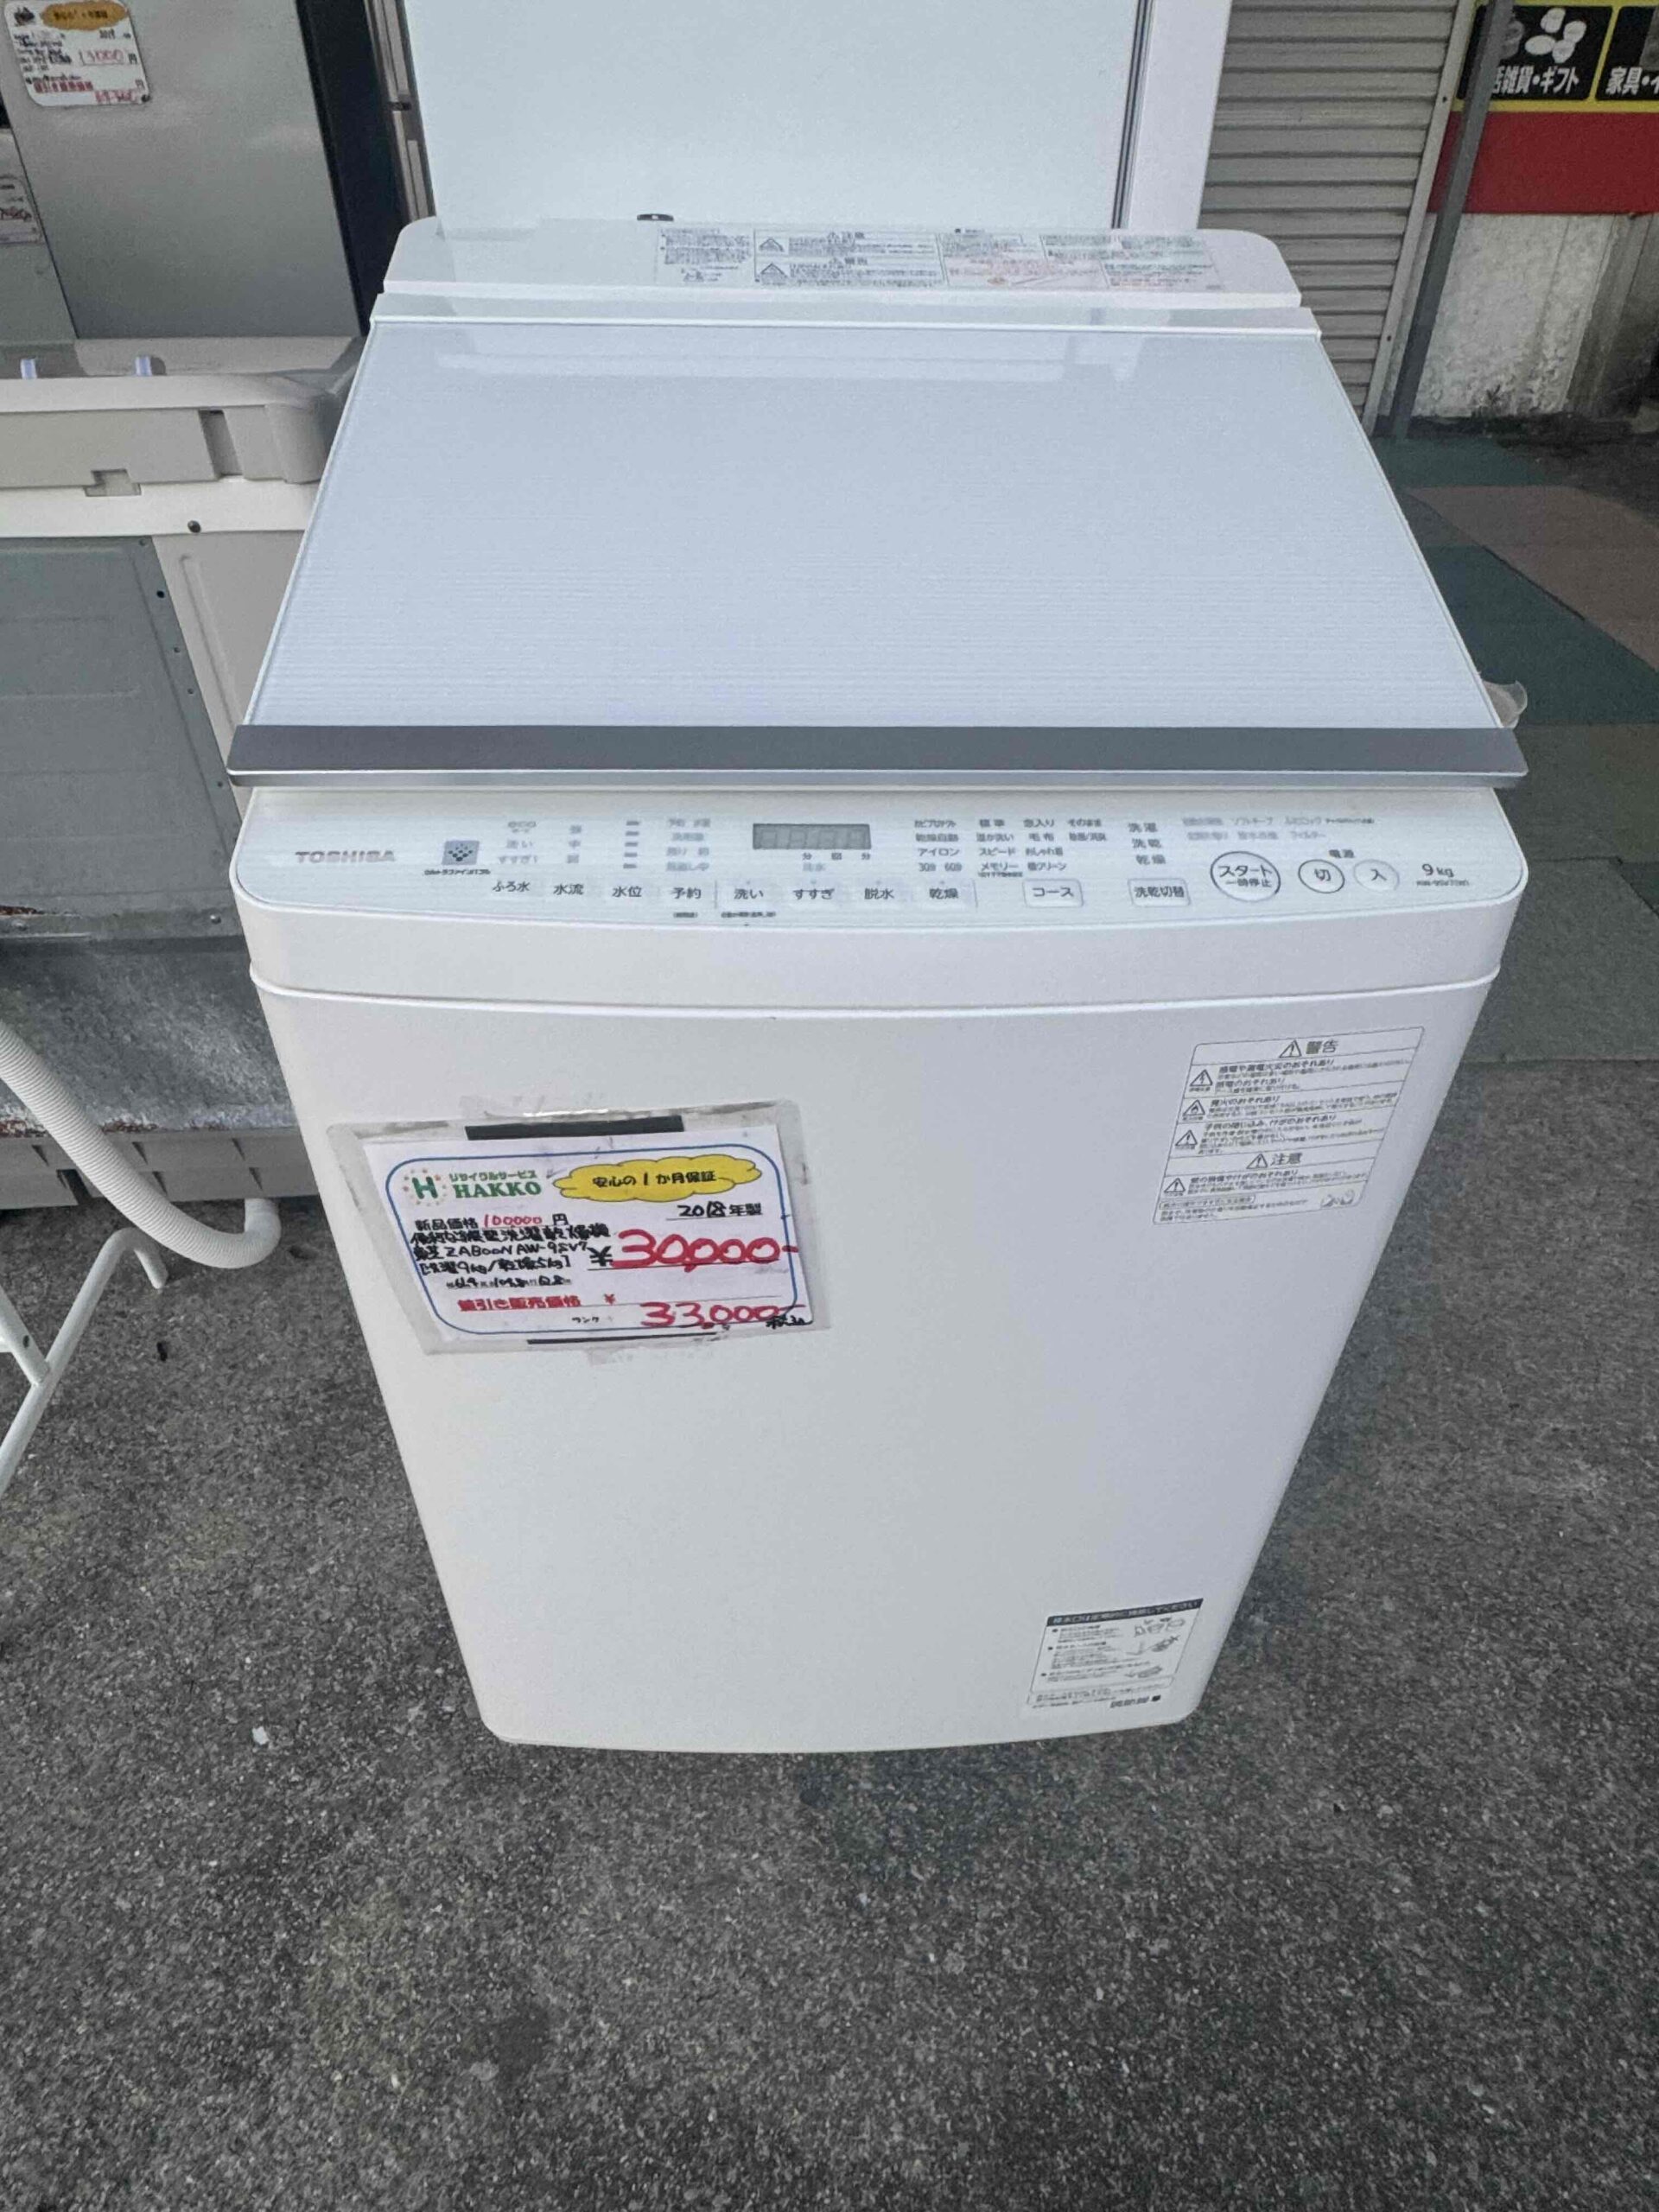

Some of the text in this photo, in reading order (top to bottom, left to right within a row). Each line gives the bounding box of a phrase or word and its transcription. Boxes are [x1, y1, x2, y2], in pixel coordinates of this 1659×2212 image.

[295, 850, 395, 863] TOSHIBA
[1218, 864, 1273, 877] スタート
[1313, 868, 1332, 882] 切
[1370, 868, 1387, 882] 入
[492, 880, 531, 893] ふろ水
[553, 883, 584, 896] 水流
[612, 886, 643, 898] 水位
[671, 887, 702, 899] 予約
[929, 887, 959, 899] 乾燥
[1033, 887, 1074, 898] コース
[734, 888, 764, 900] 洗い
[793, 888, 835, 900] すすぎ
[864, 887, 895, 900] 脱水
[1270, 1153, 1303, 1166] 注意
[448, 1170, 537, 1182] リサイクルサービス
[453, 1180, 542, 1199] HAKKO
[415, 1217, 479, 1231] 新品価格
[551, 1213, 569, 1227] 円
